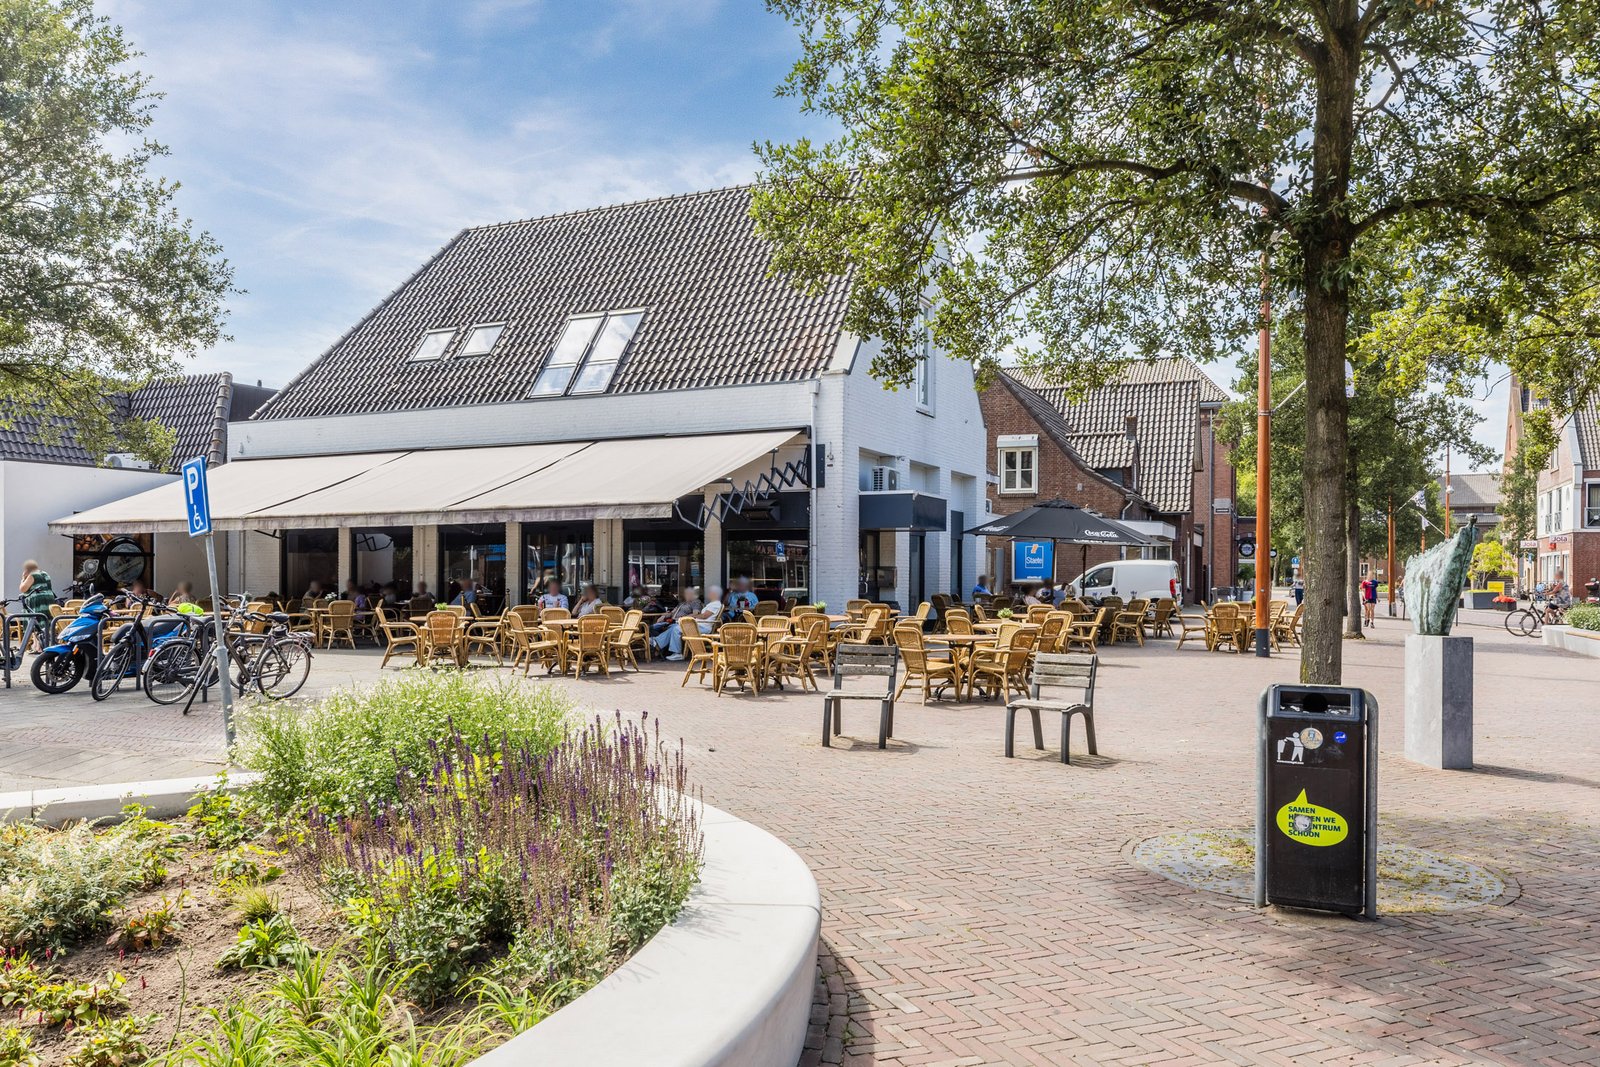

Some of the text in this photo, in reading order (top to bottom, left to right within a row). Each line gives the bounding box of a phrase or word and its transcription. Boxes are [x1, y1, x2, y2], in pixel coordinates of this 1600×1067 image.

[186, 467, 199, 504] P
[1288, 806, 1316, 814] SAMEN
[1288, 814, 1321, 822] HEN
[1310, 823, 1341, 832] NTRUM
[1288, 830, 1320, 838] SCHOON
